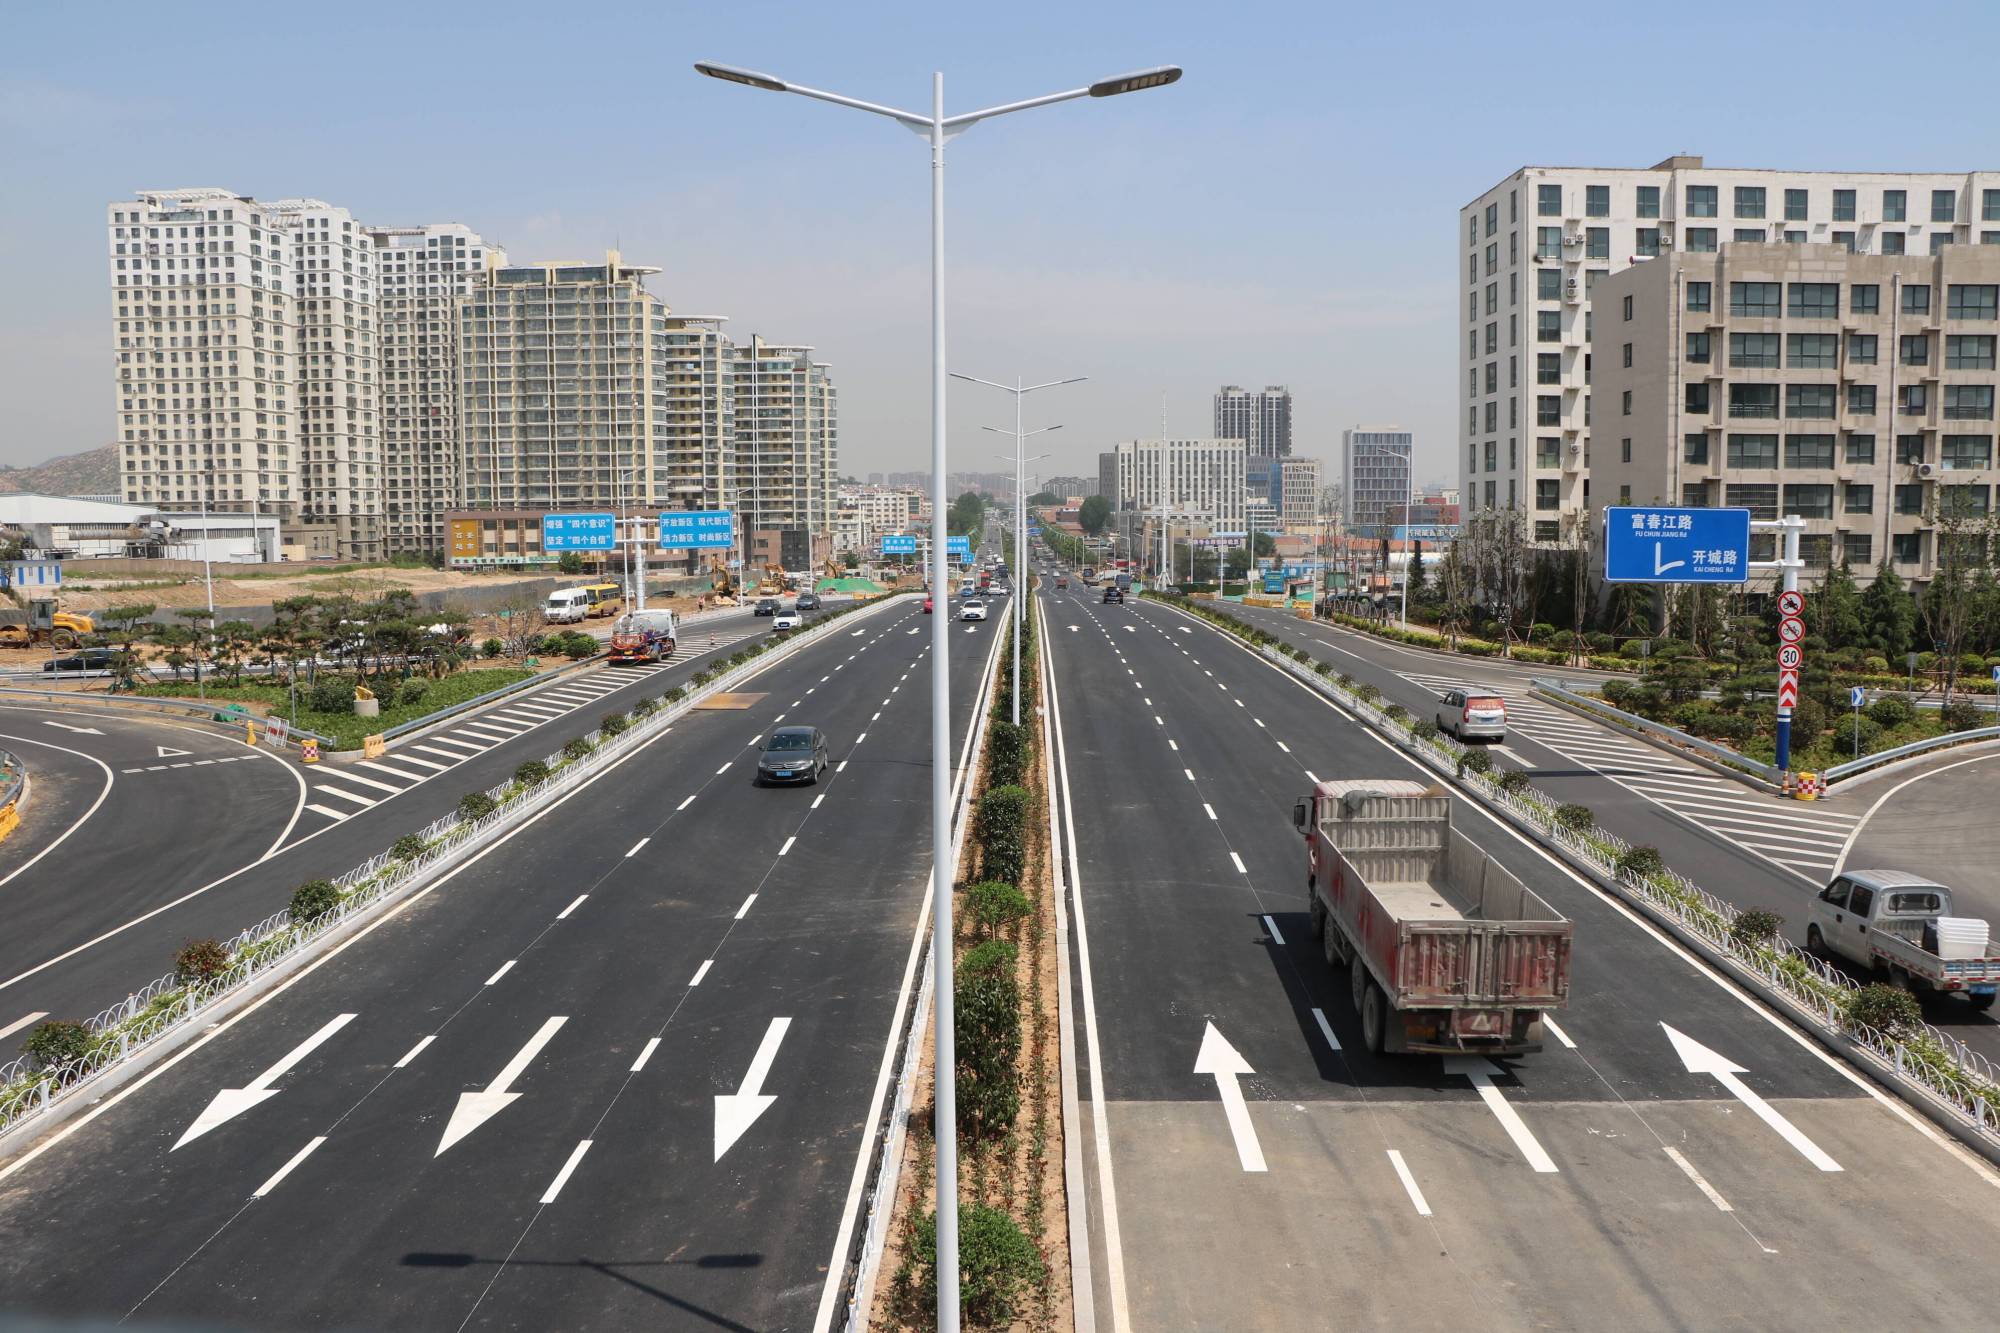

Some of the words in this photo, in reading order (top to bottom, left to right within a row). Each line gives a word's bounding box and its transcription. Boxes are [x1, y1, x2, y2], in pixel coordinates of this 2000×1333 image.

[546, 519, 563, 529] 增强
[567, 518, 610, 528] “四个意识”
[698, 516, 730, 526] 现代新区
[1632, 513, 1692, 529] 富春江路
[546, 536, 564, 546] 坚定
[567, 535, 611, 545] “四个自信”
[663, 533, 694, 543] 活力新区
[698, 532, 730, 542] 时尚新区
[1692, 549, 1737, 565] 开城路
[1783, 650, 1797, 664] 30
